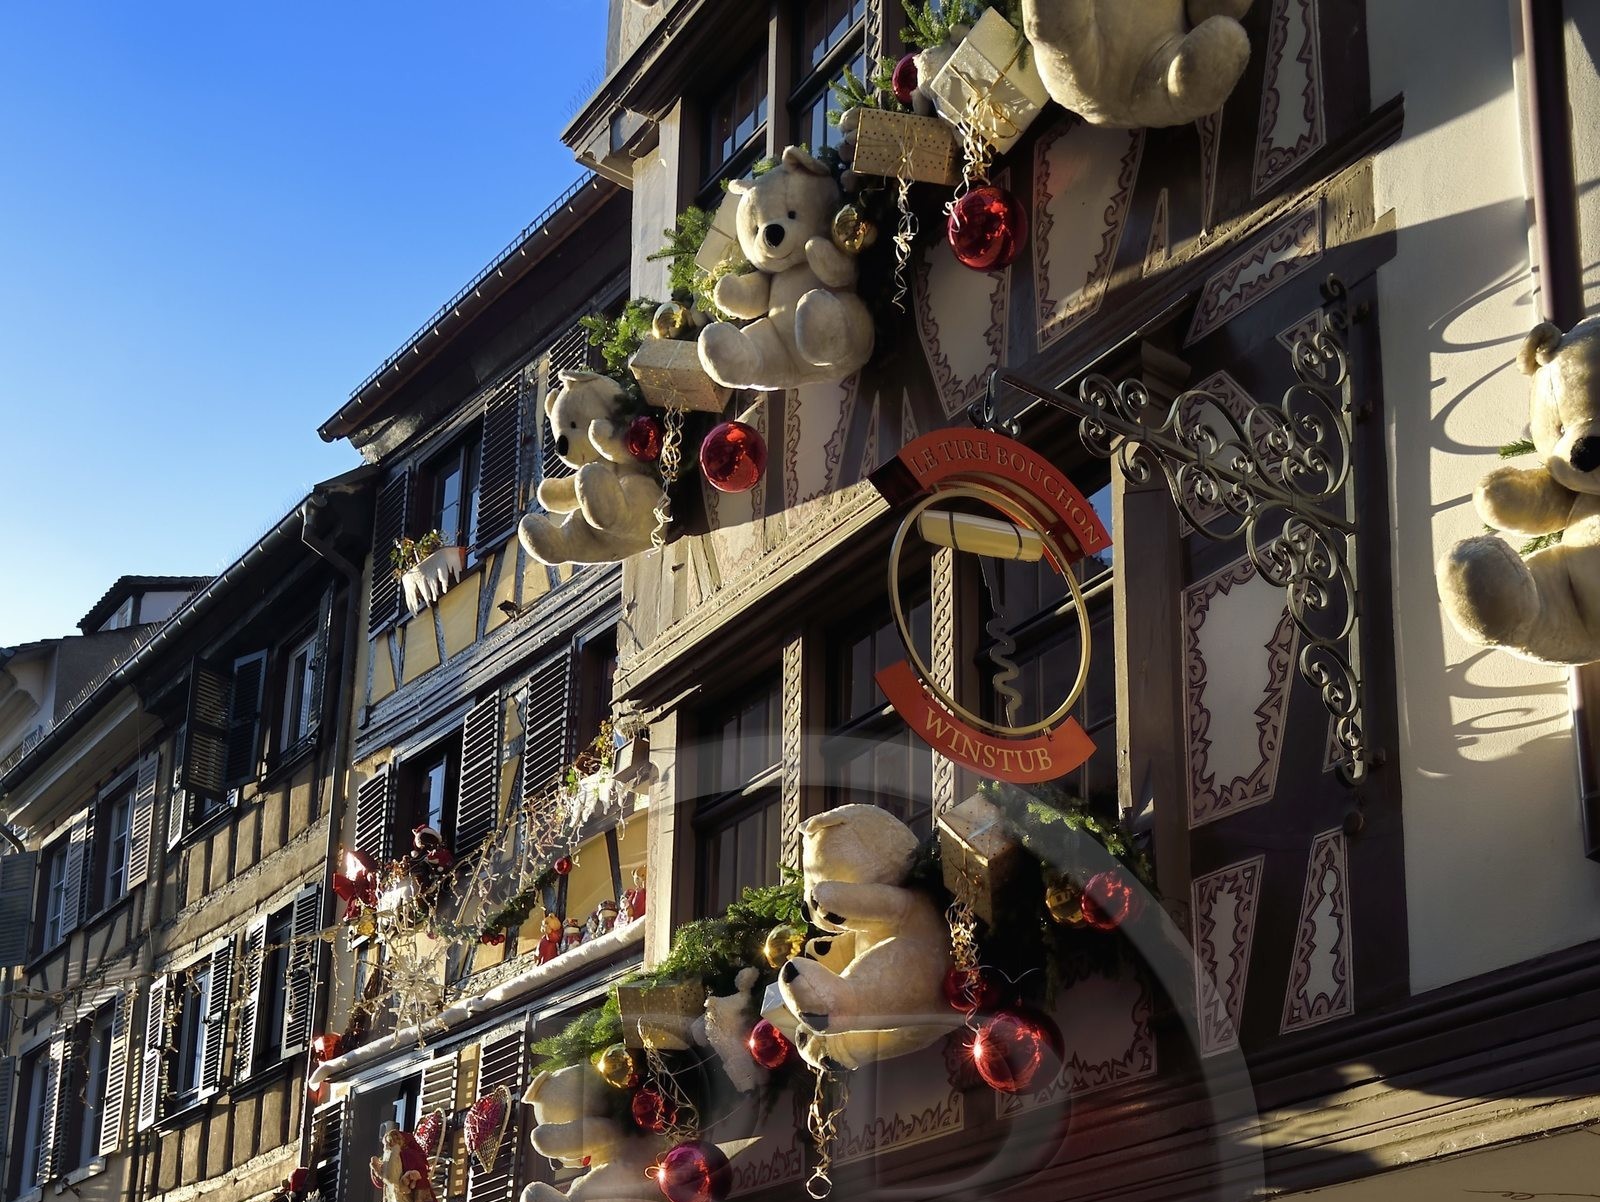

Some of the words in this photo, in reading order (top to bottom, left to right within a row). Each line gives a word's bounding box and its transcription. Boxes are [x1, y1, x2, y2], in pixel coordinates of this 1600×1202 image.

[910, 445, 938, 477] LE
[937, 439, 991, 462] TIRE
[996, 450, 1102, 546] BOUCHON
[923, 706, 1053, 774] WINSTUB
